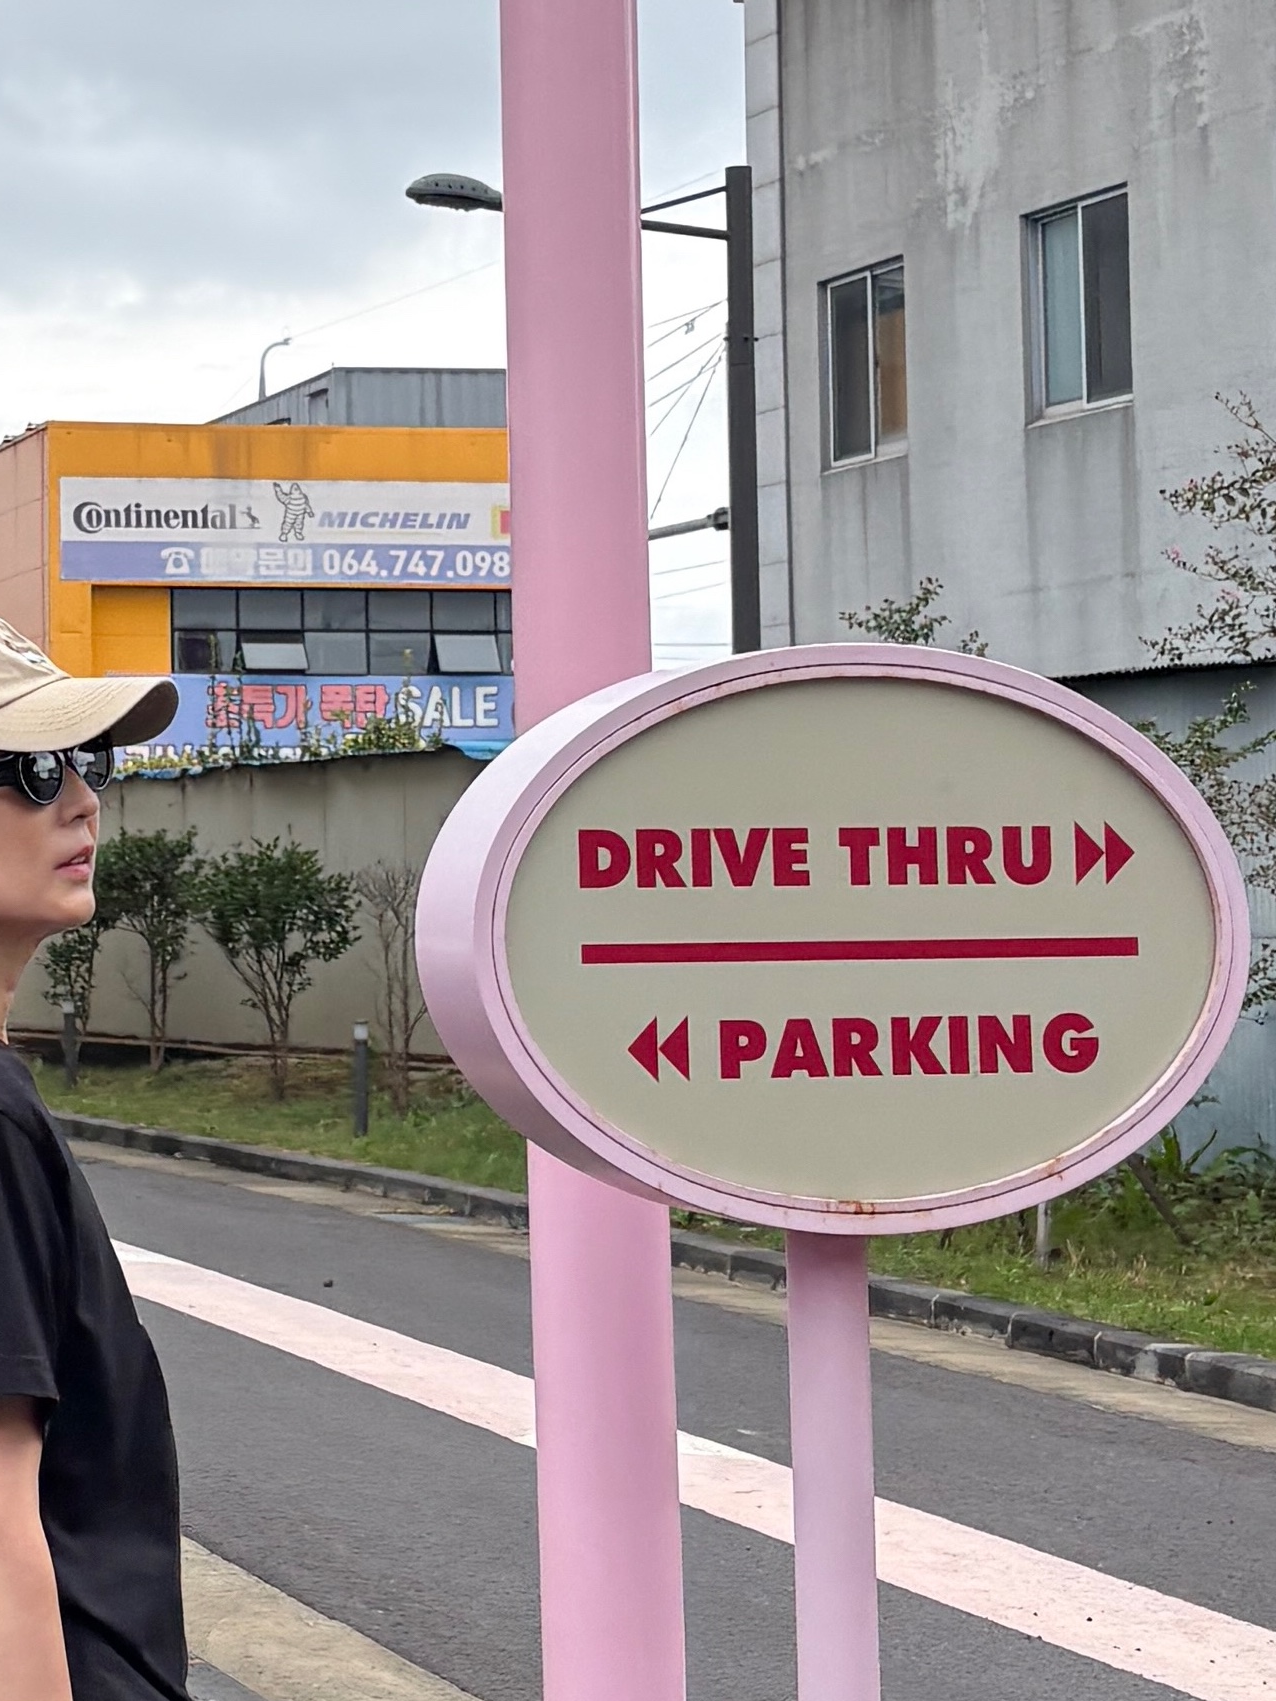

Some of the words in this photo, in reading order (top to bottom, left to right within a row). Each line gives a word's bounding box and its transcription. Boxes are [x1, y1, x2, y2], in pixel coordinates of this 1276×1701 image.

[72, 501, 237, 534] Continental
[318, 511, 471, 530] MICHELIN
[395, 684, 499, 728] SALE
[577, 828, 811, 889] DRIVE
[838, 826, 1052, 886] THRU
[719, 1012, 1100, 1080] PARKING
